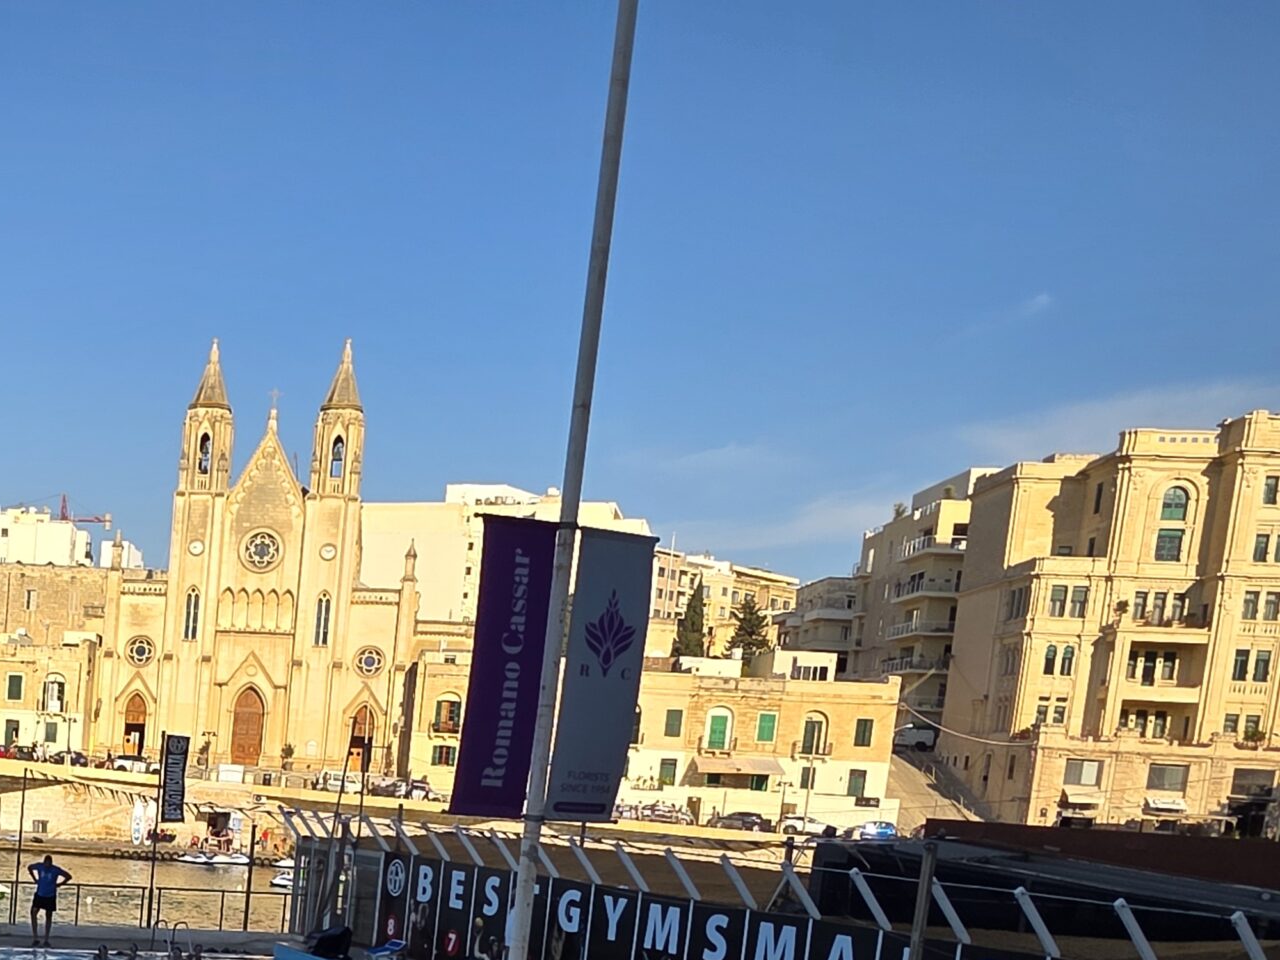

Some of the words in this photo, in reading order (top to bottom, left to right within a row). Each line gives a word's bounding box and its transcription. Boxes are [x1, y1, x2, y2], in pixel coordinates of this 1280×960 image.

[481, 661, 520, 787] Romano
[501, 548, 530, 654] Cassar
[416, 863, 541, 918] BES
[386, 918, 396, 936] 8
[447, 932, 457, 952] 7
